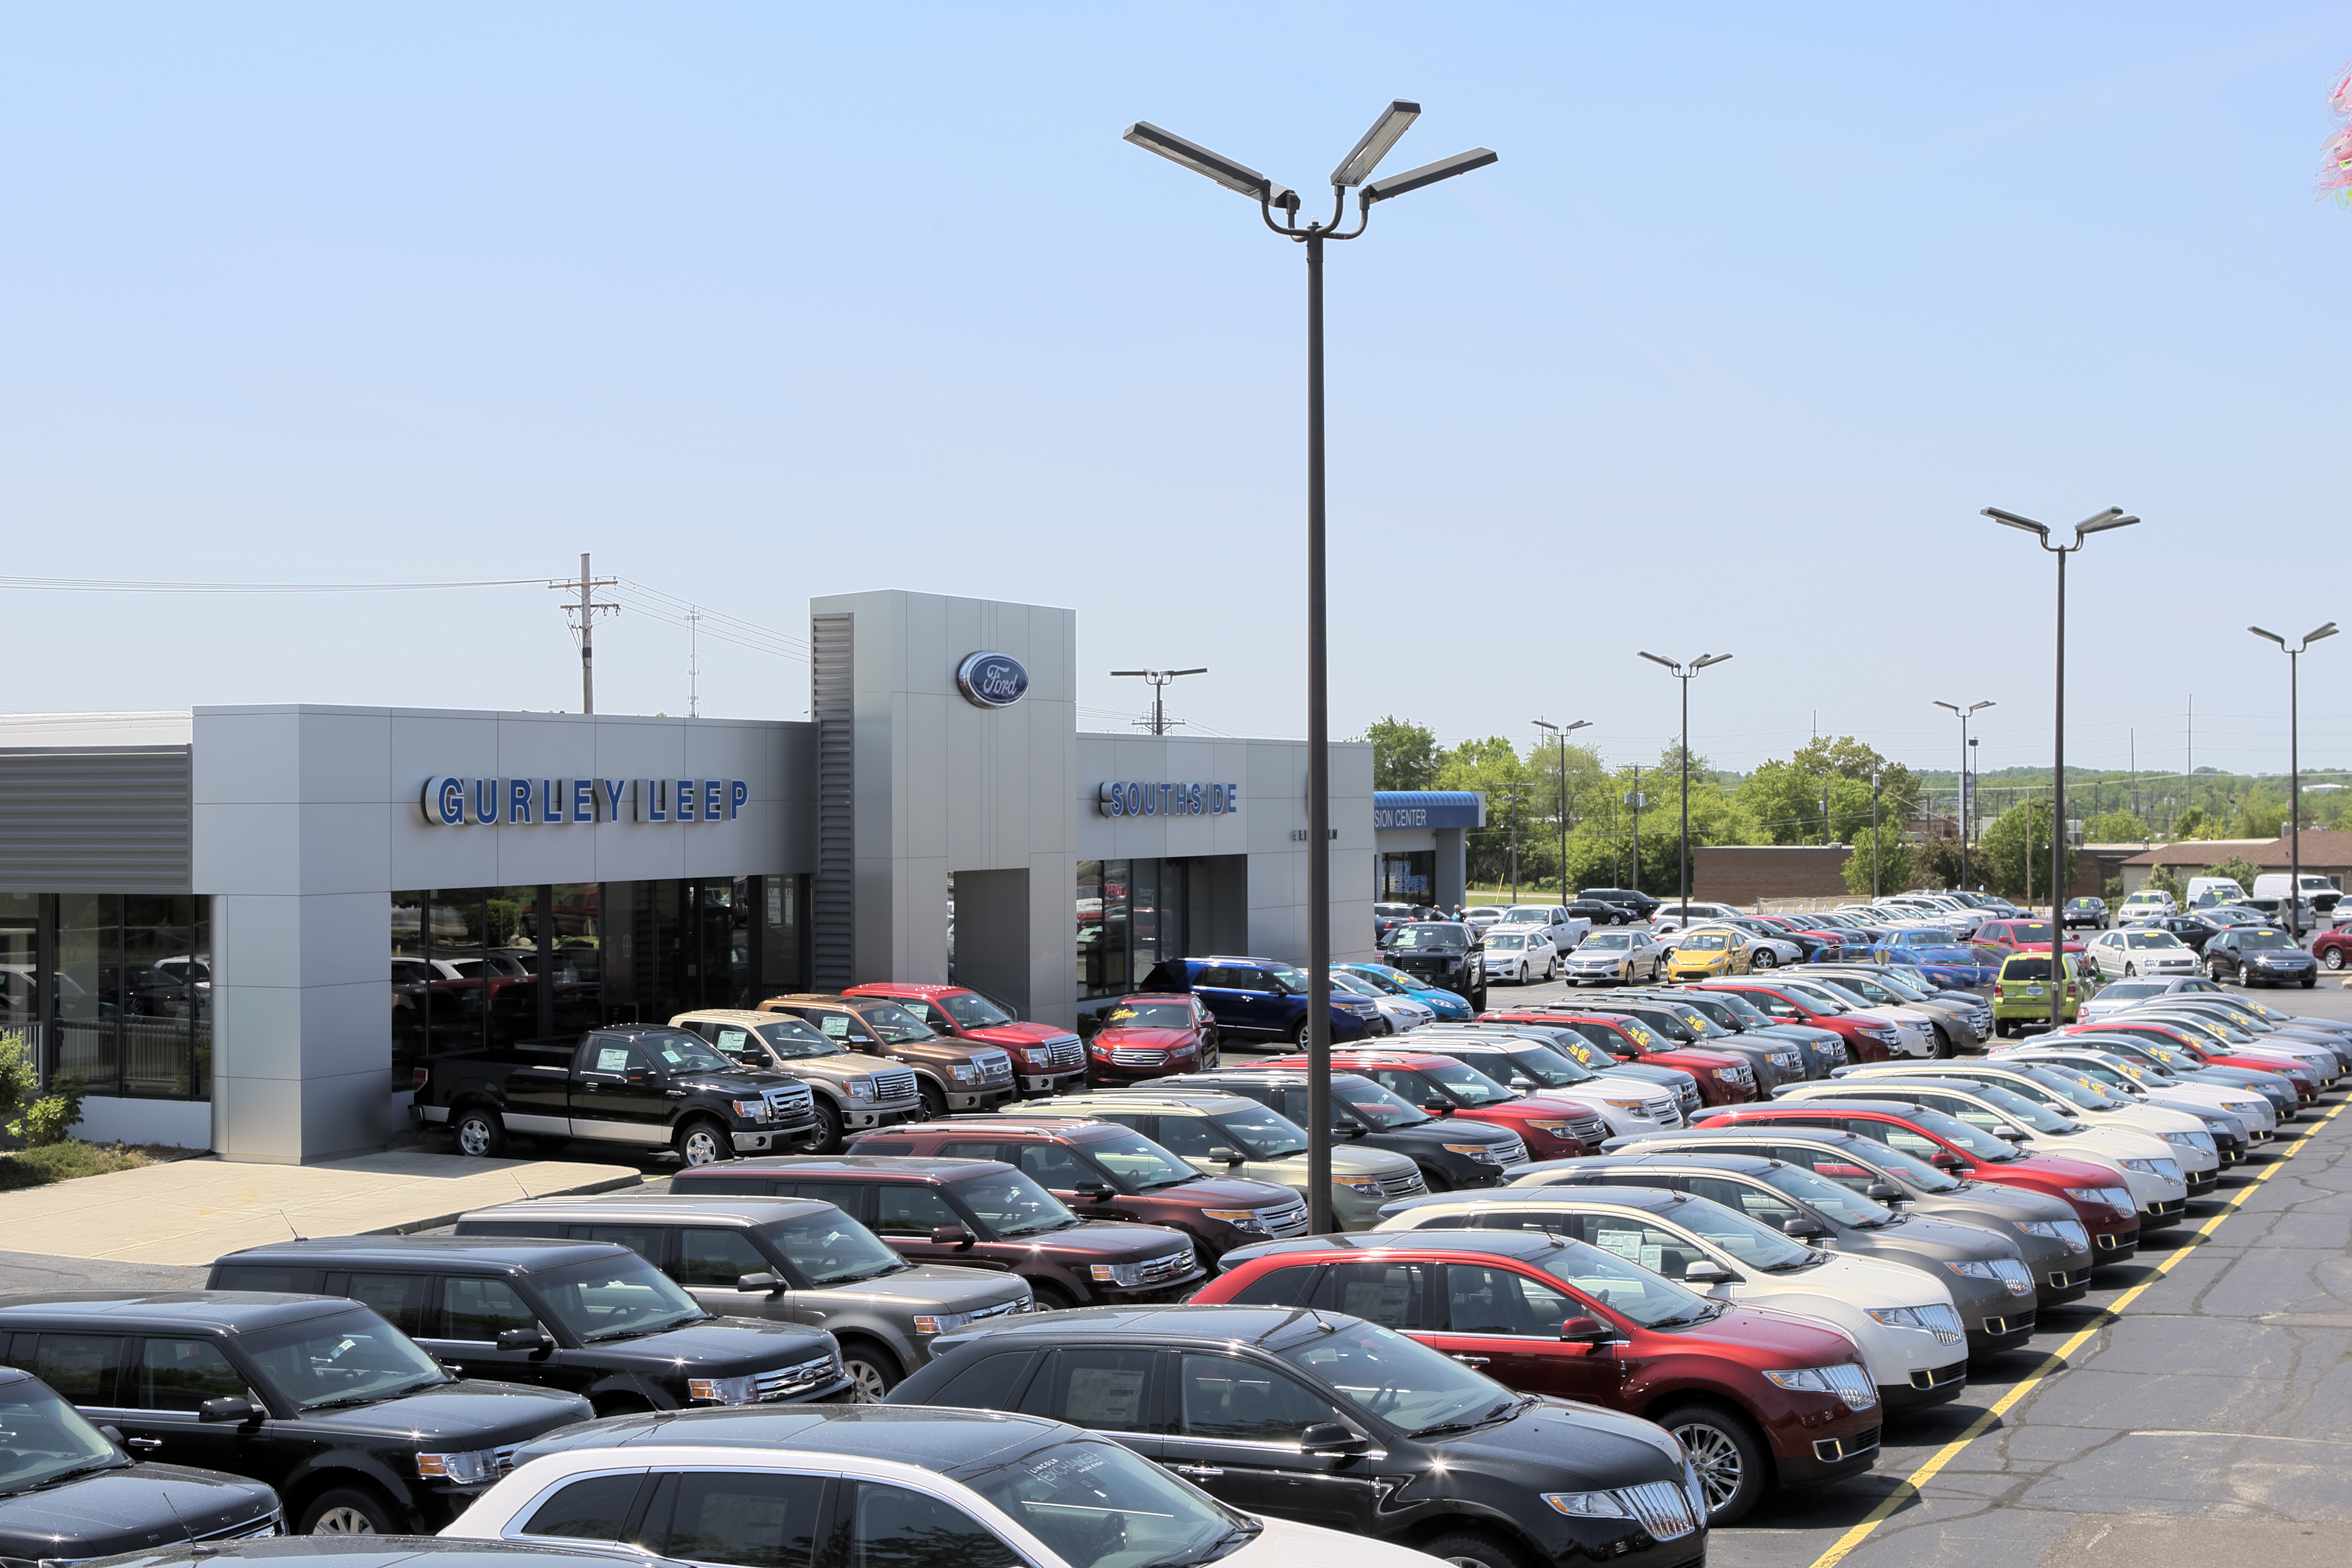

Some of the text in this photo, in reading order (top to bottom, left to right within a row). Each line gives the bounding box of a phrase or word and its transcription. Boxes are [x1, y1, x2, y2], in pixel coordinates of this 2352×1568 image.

[983, 664, 1018, 695] Ford
[437, 776, 749, 826] GURLEY LEEP
[1109, 781, 1237, 817] SOUTHSIDE
[1395, 809, 1427, 827] CENTER
[1398, 875, 1428, 894] EXPRESS
[1029, 1458, 1059, 1474] LINCOLN
[1038, 1453, 1099, 1483] EXCHANGE
[1078, 1465, 1093, 1474] SALES
